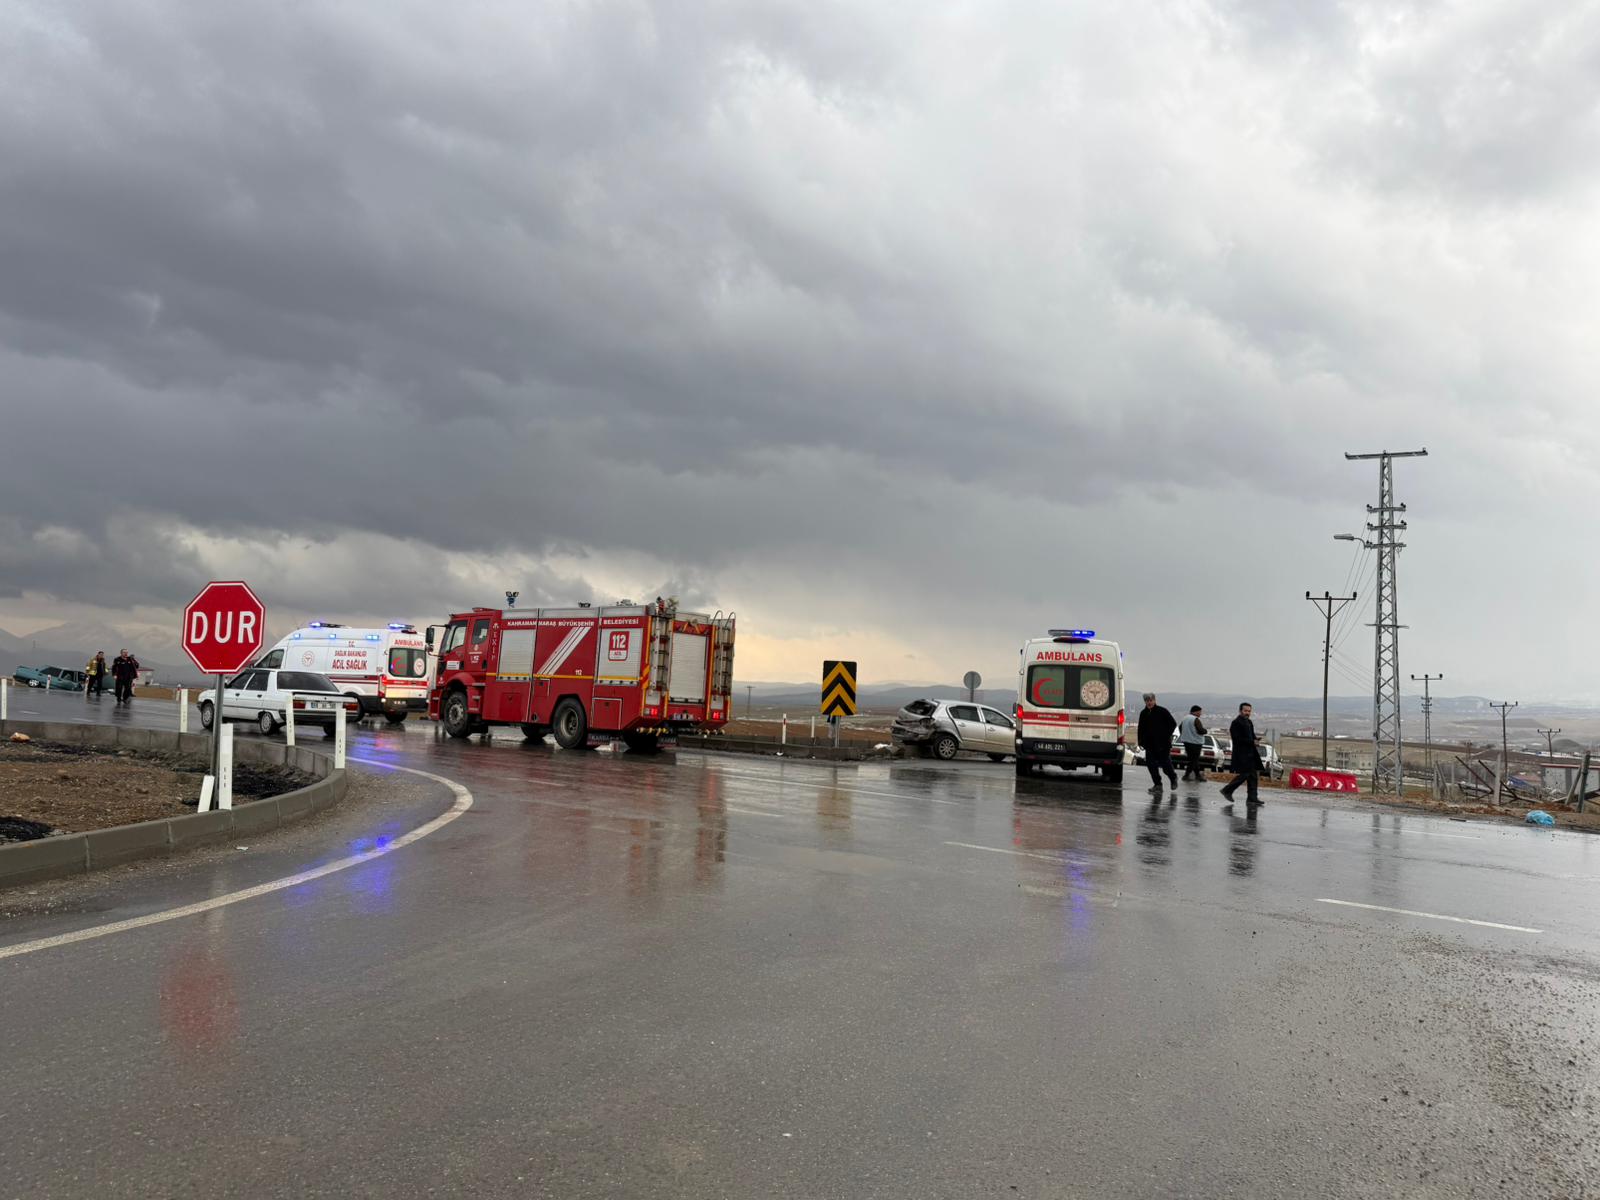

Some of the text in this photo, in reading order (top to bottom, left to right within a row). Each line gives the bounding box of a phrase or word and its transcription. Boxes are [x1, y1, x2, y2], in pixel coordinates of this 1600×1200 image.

[603, 617, 639, 625] BELEDİYESİ
[190, 610, 256, 644] DUR
[394, 639, 424, 647] AMBULANS
[612, 634, 626, 649] 112
[1036, 651, 1103, 662] AMBULANS
[346, 659, 368, 670] SAĞLIK
